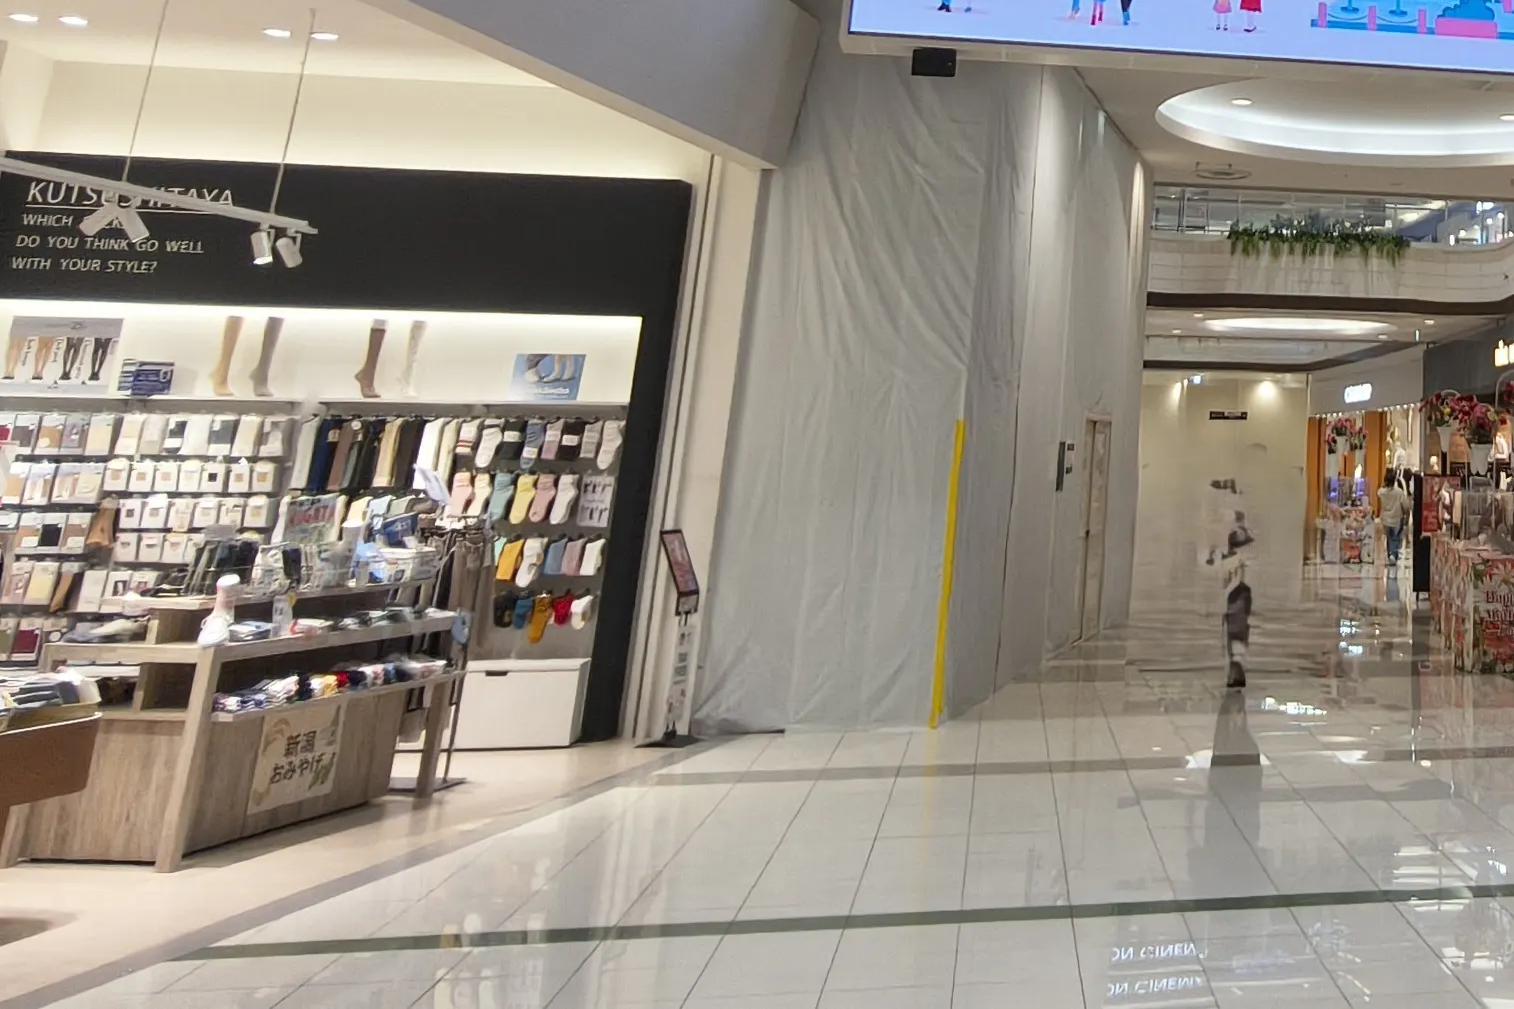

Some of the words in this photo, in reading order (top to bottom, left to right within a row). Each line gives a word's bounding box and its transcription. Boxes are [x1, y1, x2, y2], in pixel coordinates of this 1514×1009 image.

[22, 214, 74, 228] WHICH
[16, 235, 40, 248] DO
[47, 236, 80, 249] YOU
[84, 237, 129, 251] THINK
[135, 239, 159, 252] GO
[165, 240, 204, 254] WELL
[11, 257, 51, 271] WITH
[60, 258, 101, 272] YOUR
[105, 259, 157, 274] STYLE?
